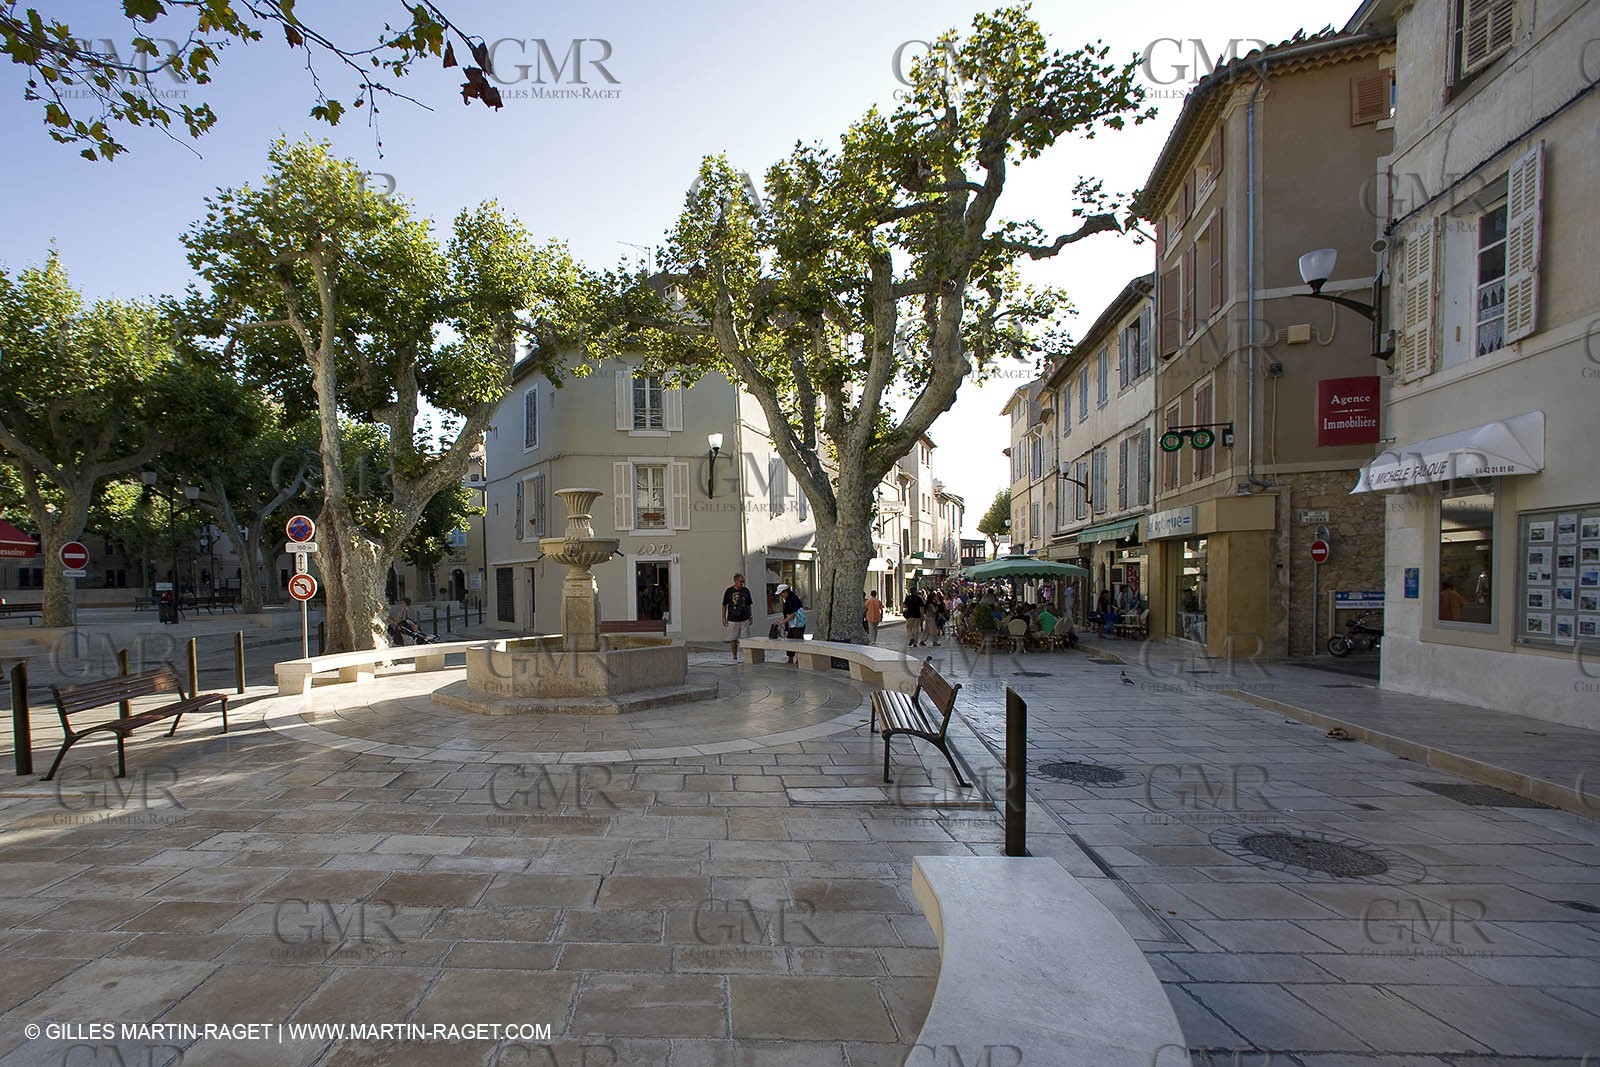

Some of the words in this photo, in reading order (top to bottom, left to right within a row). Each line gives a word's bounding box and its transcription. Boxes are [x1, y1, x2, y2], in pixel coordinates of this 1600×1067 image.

[1331, 395, 1371, 405] Agence
[1323, 416, 1377, 430] Immobilière
[1411, 461, 1448, 479] FALQUE
